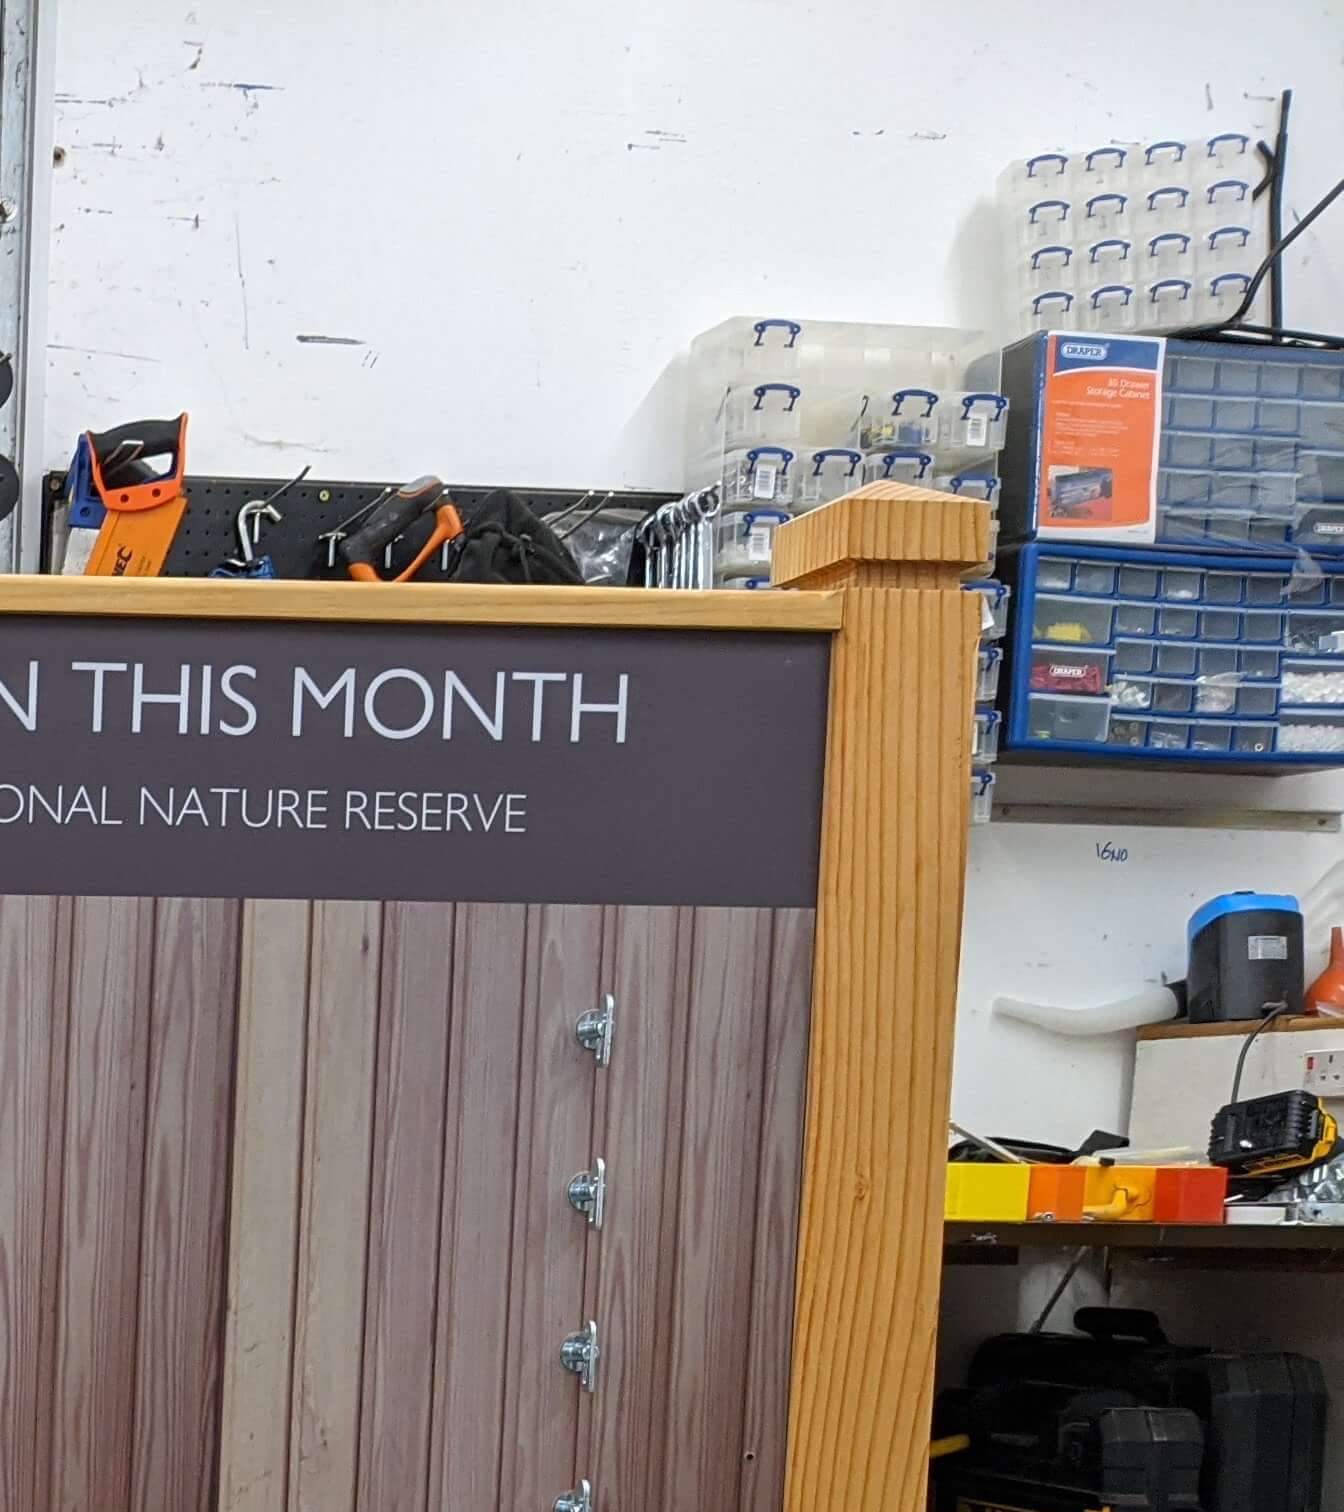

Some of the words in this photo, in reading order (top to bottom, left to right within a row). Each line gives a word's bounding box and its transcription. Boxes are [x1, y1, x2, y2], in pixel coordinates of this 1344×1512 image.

[71, 661, 257, 736] THIS
[292, 666, 629, 744] MONTH
[139, 786, 329, 829] NATURE
[345, 790, 527, 833] RESERVE
